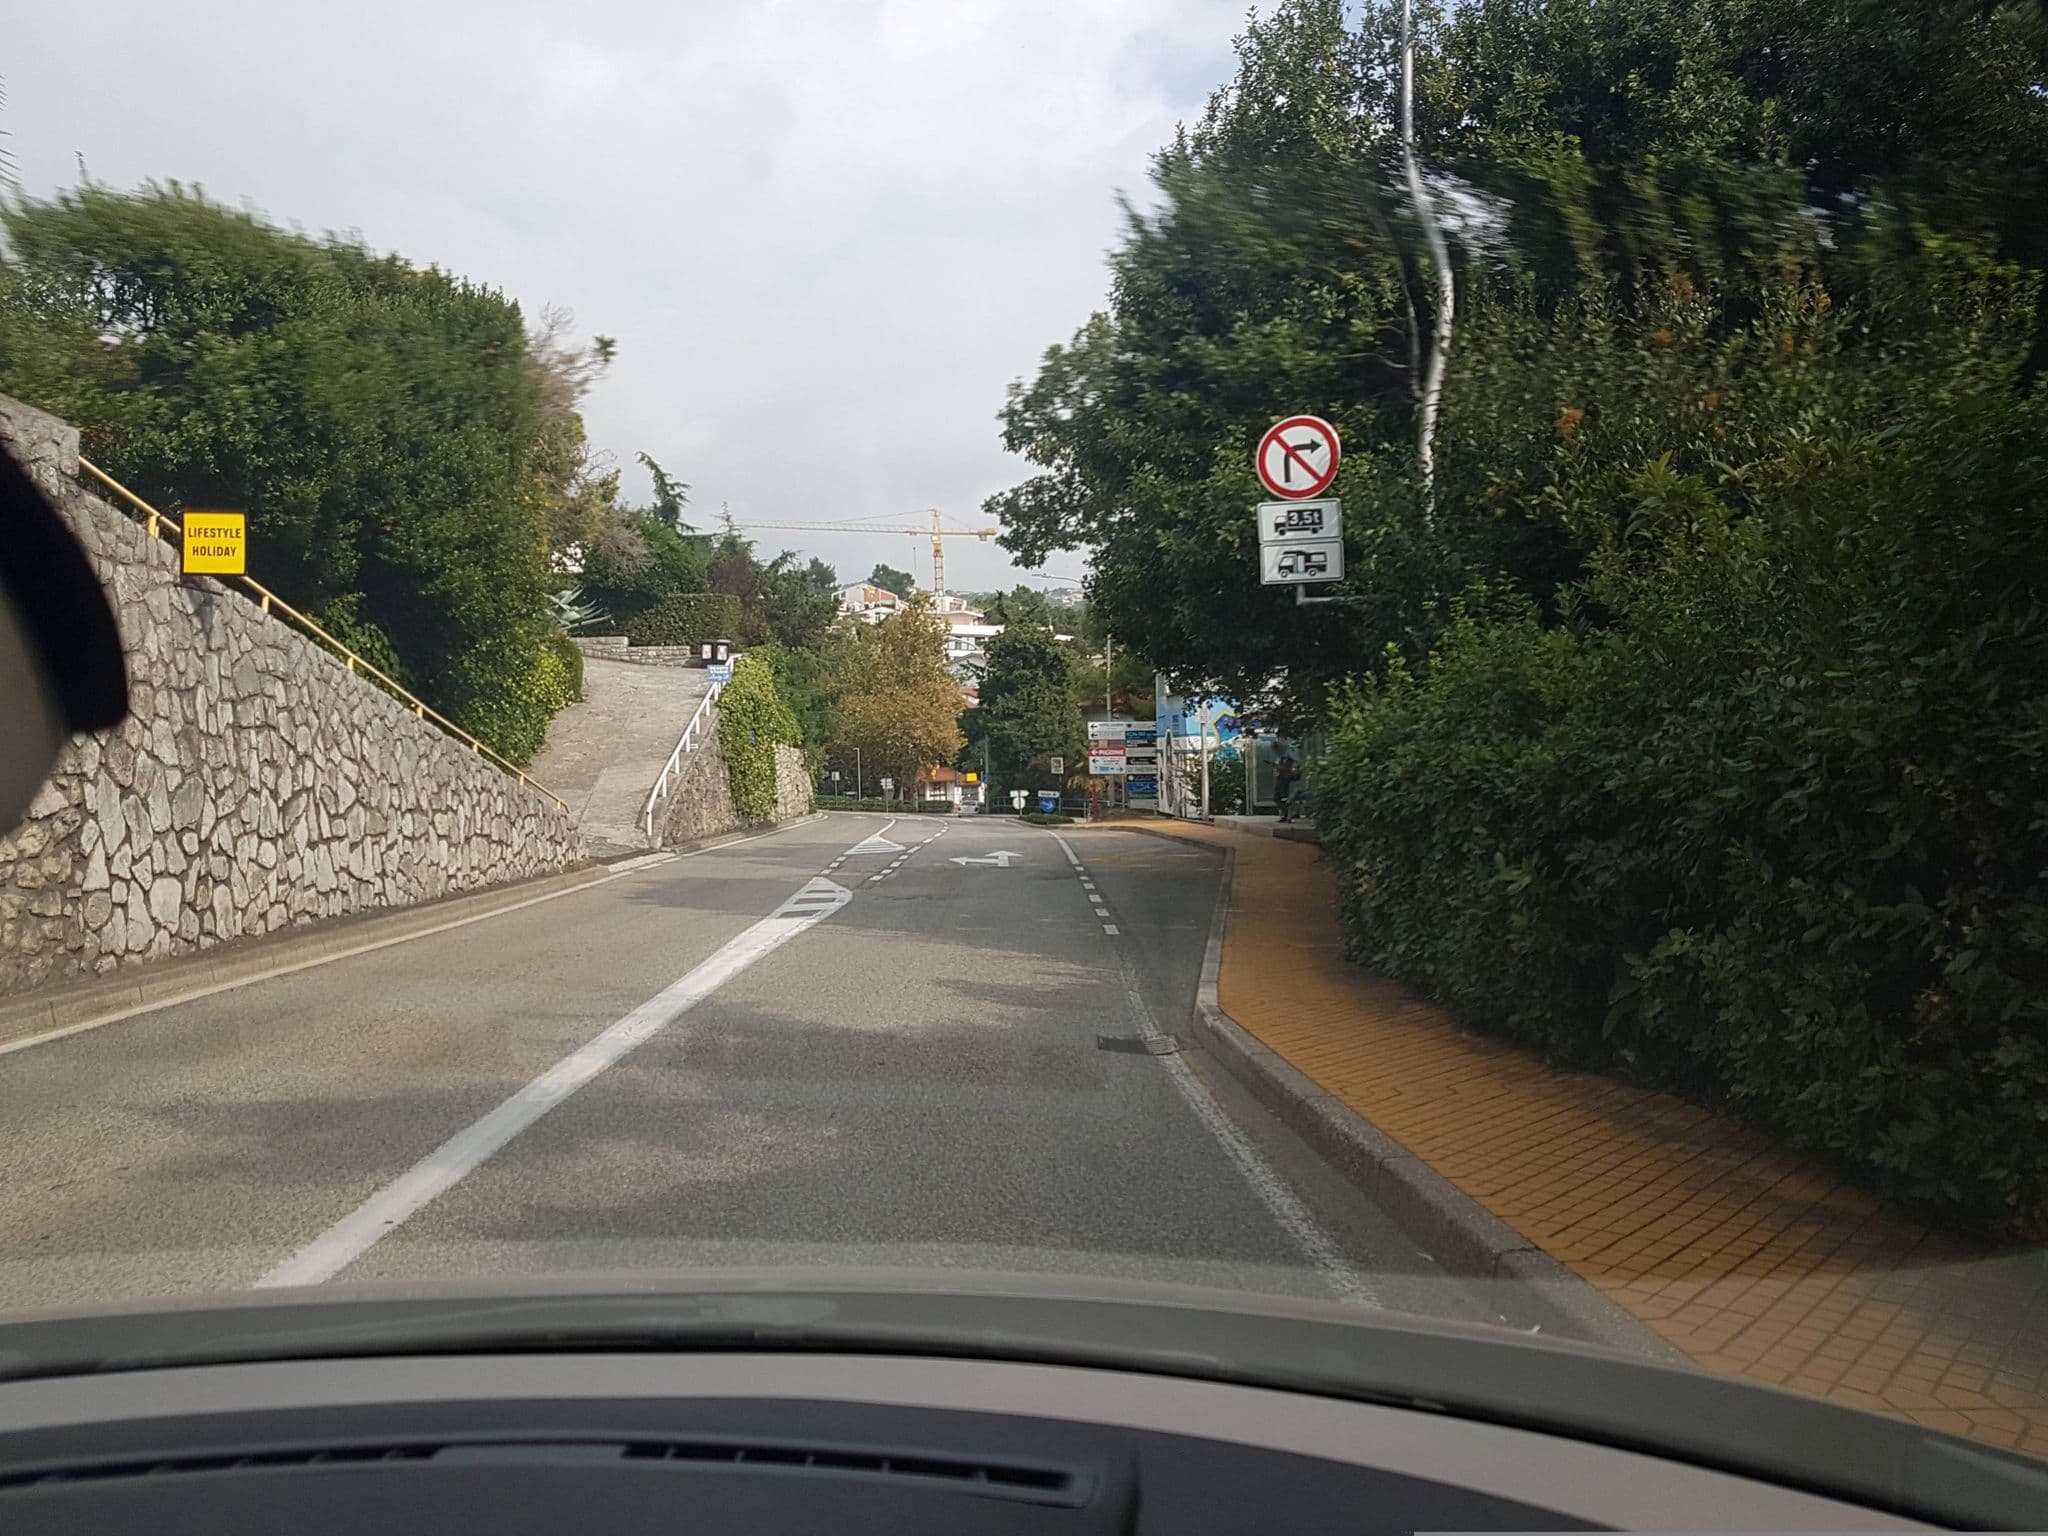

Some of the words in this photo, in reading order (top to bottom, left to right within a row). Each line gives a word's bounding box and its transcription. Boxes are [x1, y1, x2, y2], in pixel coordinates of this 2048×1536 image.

[1288, 511, 1320, 526] 3,5t
[188, 528, 241, 538] LIFESTYLE
[192, 546, 237, 557] HOLIDAY
